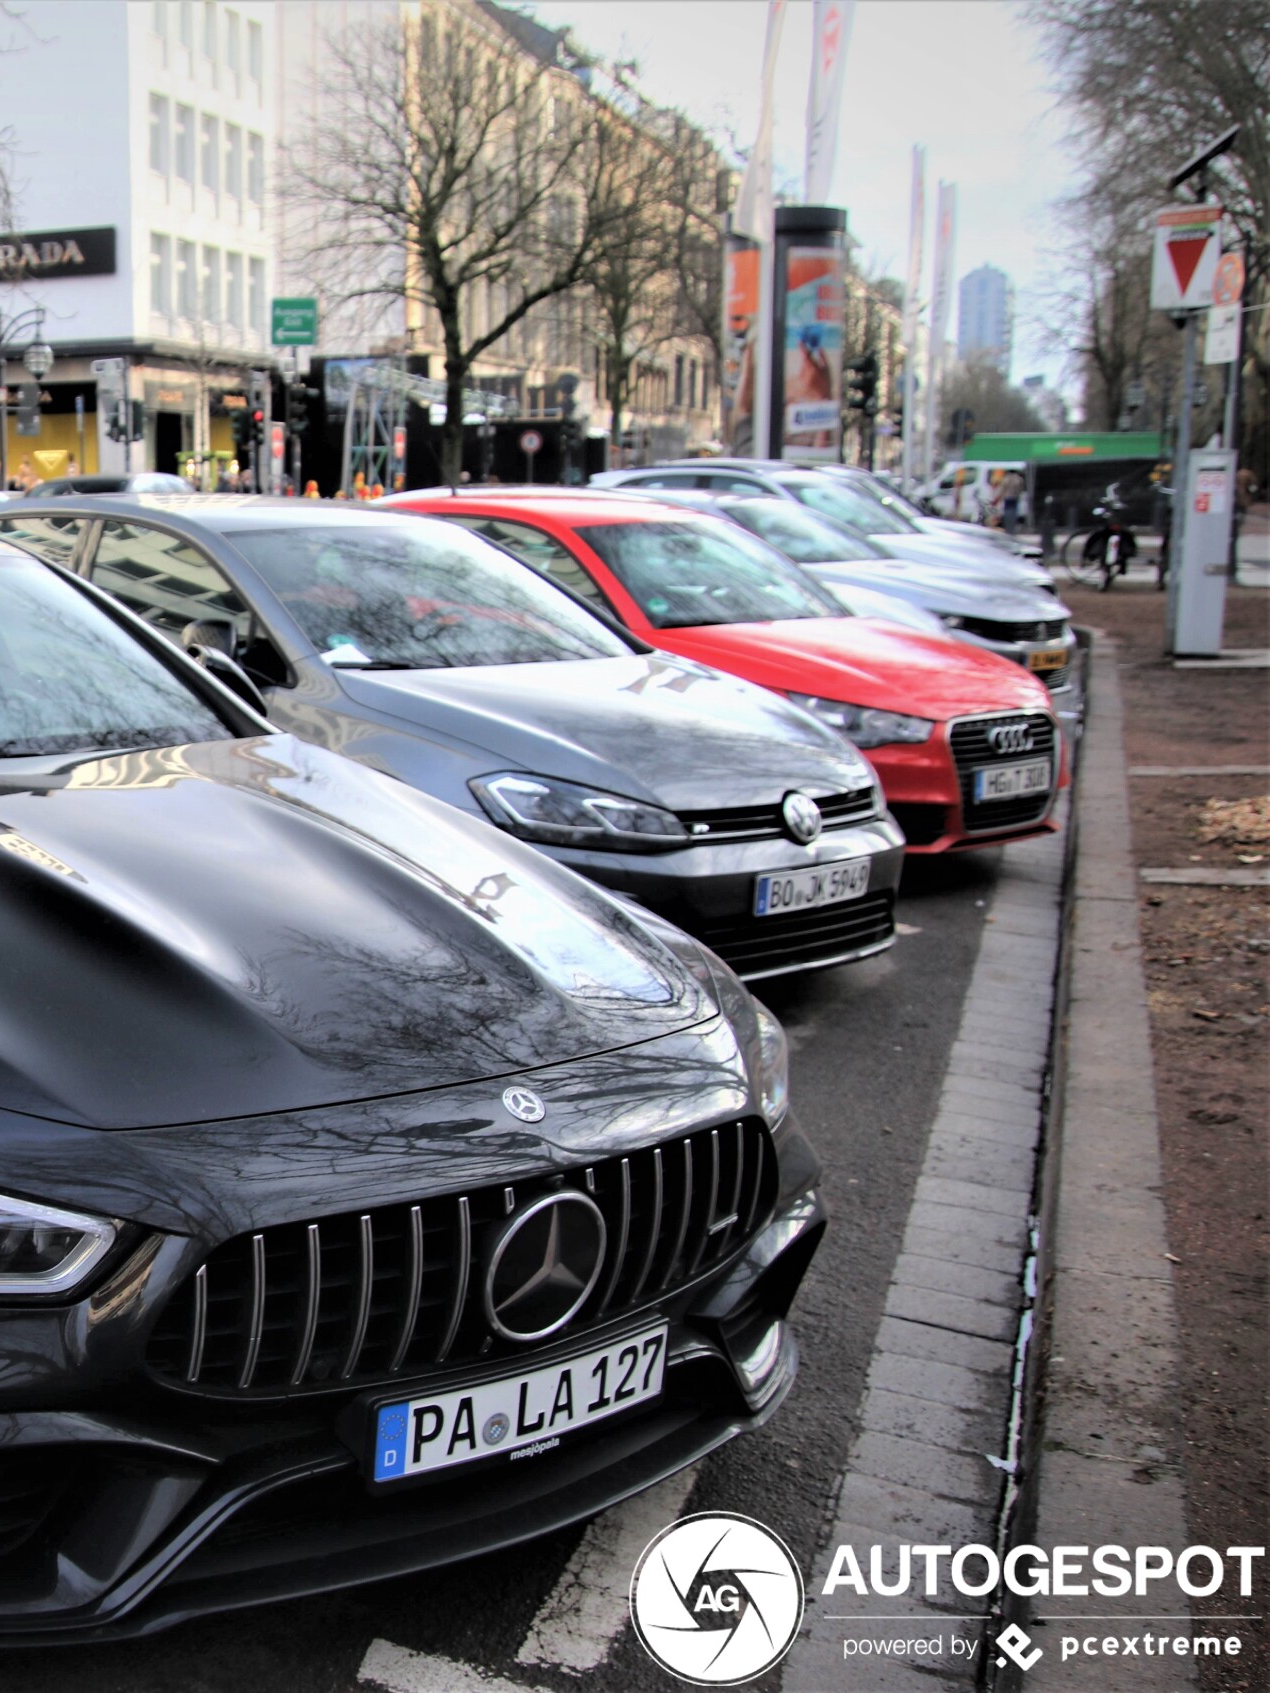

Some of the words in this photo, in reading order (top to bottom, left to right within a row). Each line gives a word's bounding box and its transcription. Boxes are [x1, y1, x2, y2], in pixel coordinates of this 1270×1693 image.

[770, 879, 794, 909] BO
[384, 1449, 397, 1468] D
[412, 1396, 477, 1464] PA
[516, 1368, 574, 1437] LA
[587, 1332, 665, 1413] 127
